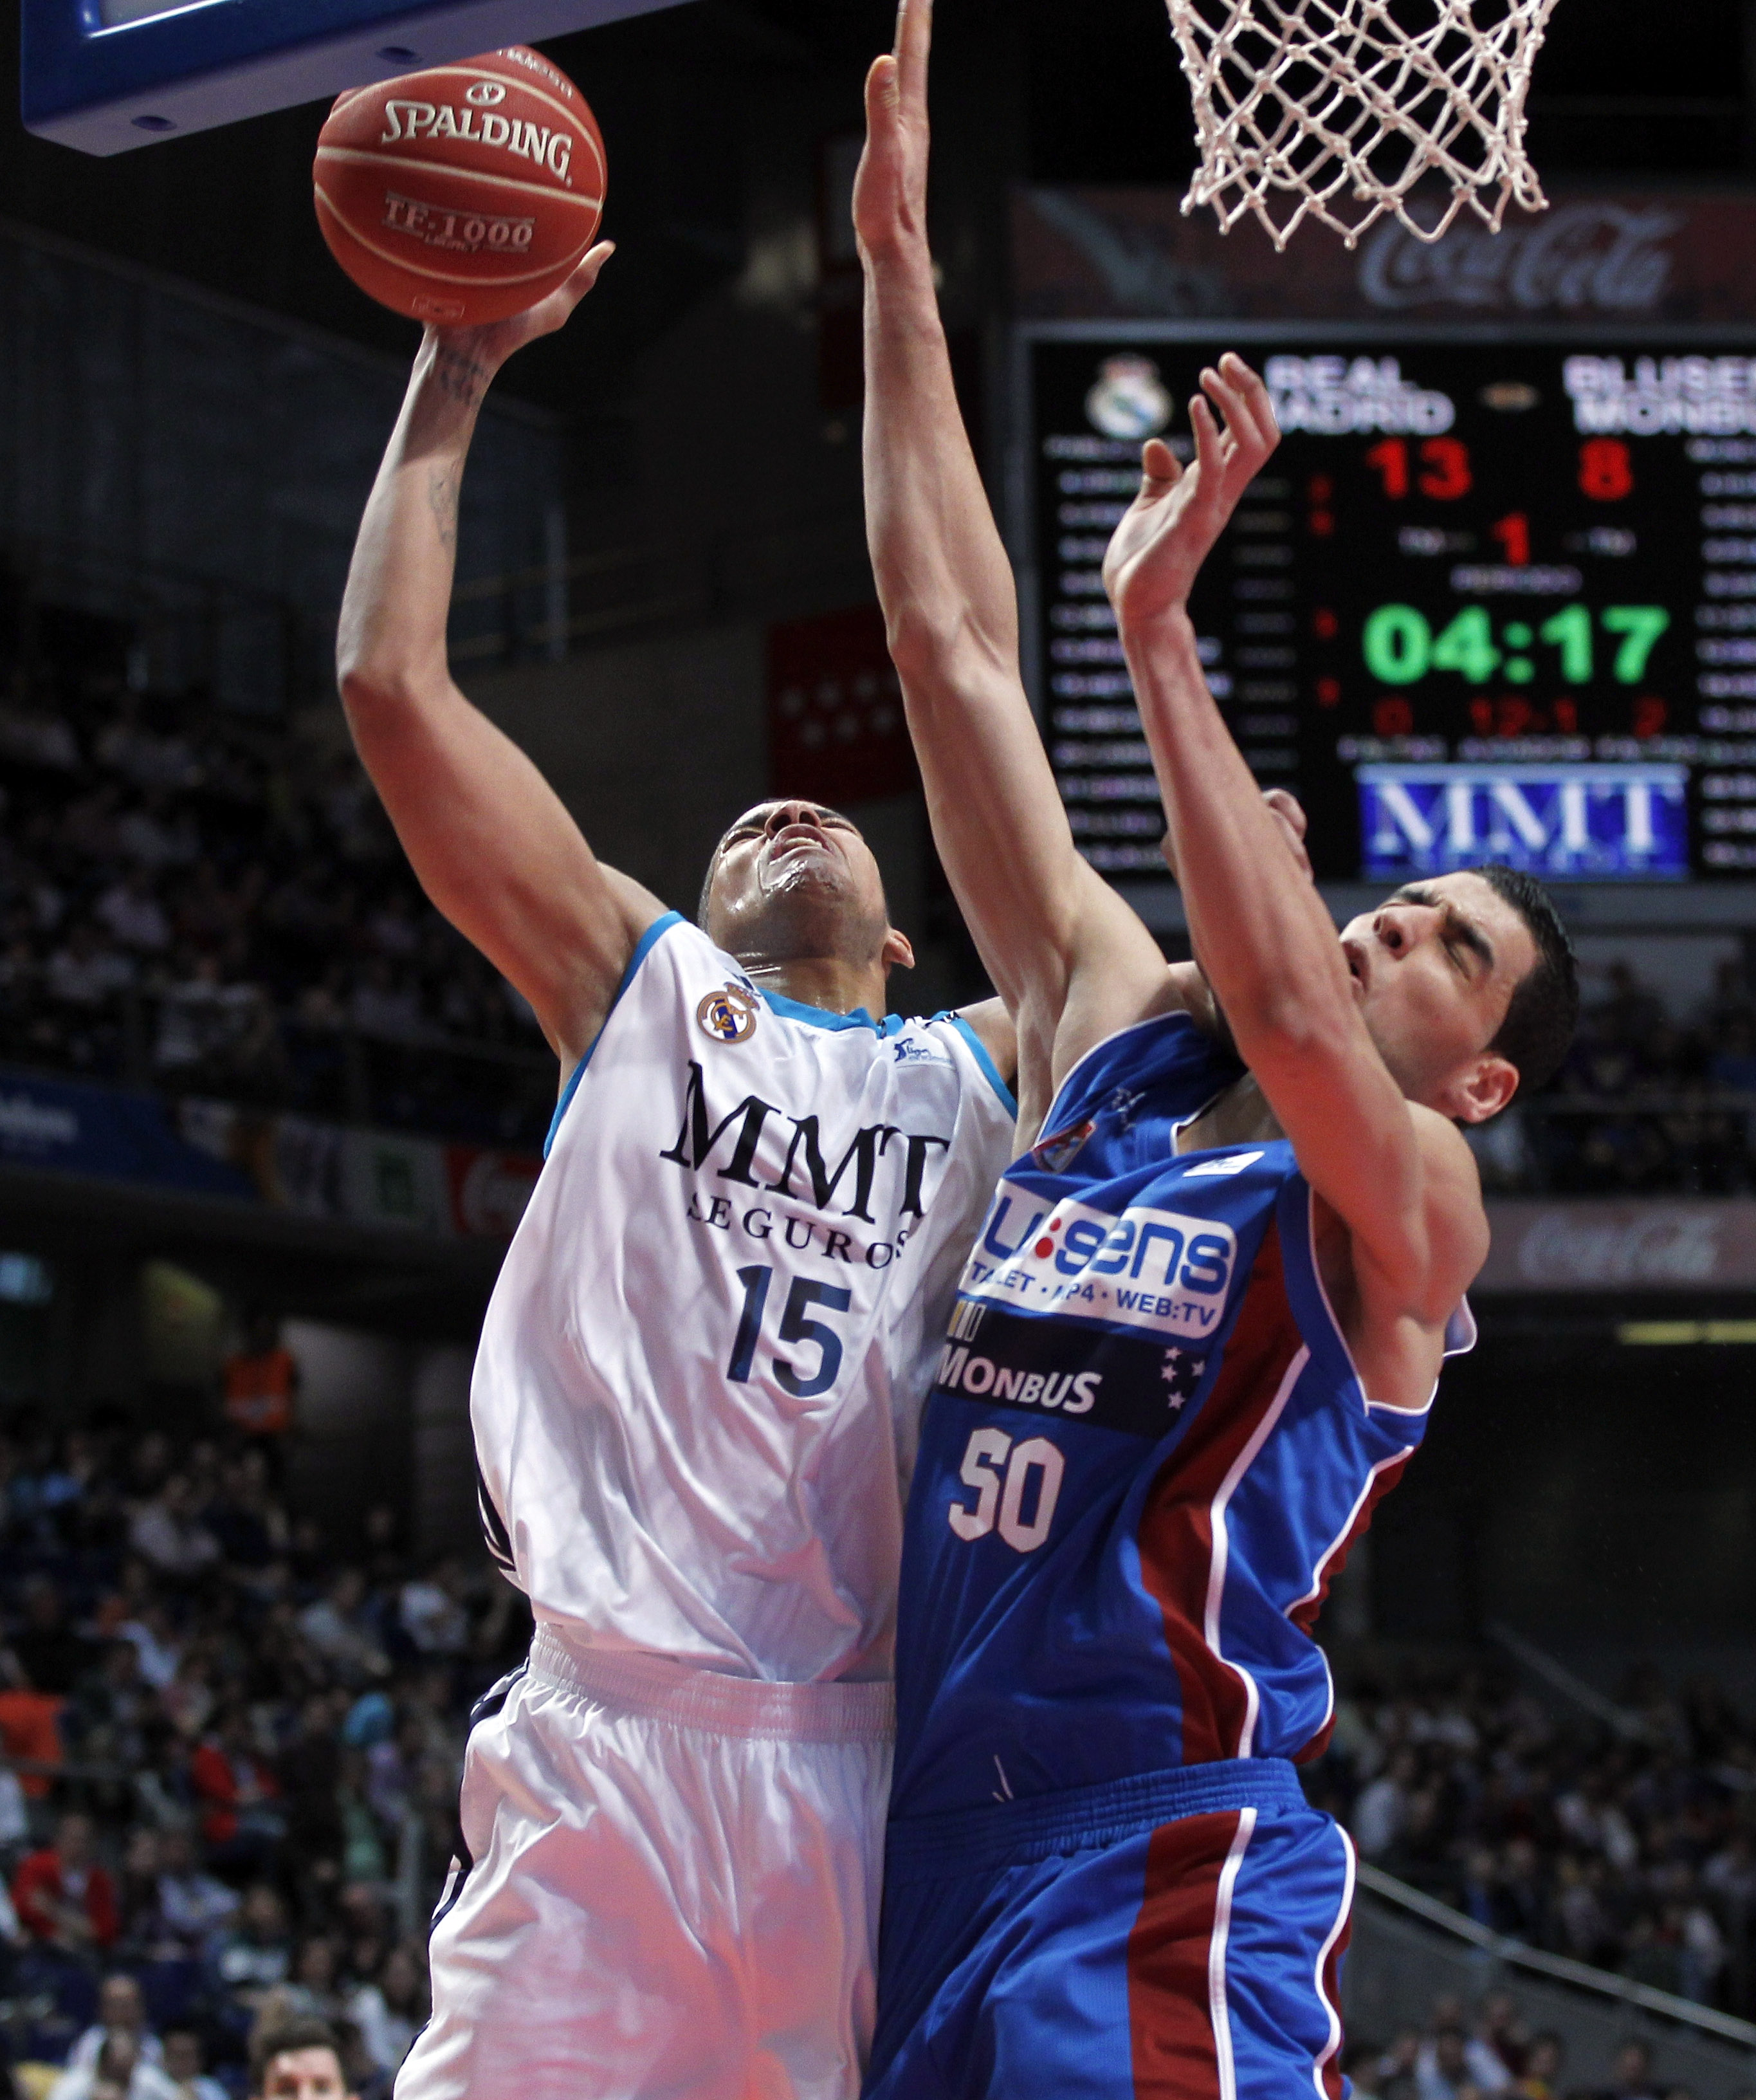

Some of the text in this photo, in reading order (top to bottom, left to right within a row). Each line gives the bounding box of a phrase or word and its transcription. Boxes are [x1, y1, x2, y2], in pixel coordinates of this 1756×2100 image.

[382, 99, 572, 185] SPALDING
[1267, 388, 1455, 436] ADRID
[1365, 437, 1473, 500] 13
[1578, 438, 1634, 501] 8
[1491, 513, 1530, 567] 1
[1362, 603, 1671, 685] 04:17
[1369, 775, 1685, 852] MMT
[660, 1060, 950, 1224] MMT
[688, 1192, 908, 1269] SEGUROS
[727, 1265, 852, 1397] 15
[1117, 1288, 1215, 1327] WEB:TV
[949, 1427, 1065, 1553] 50
